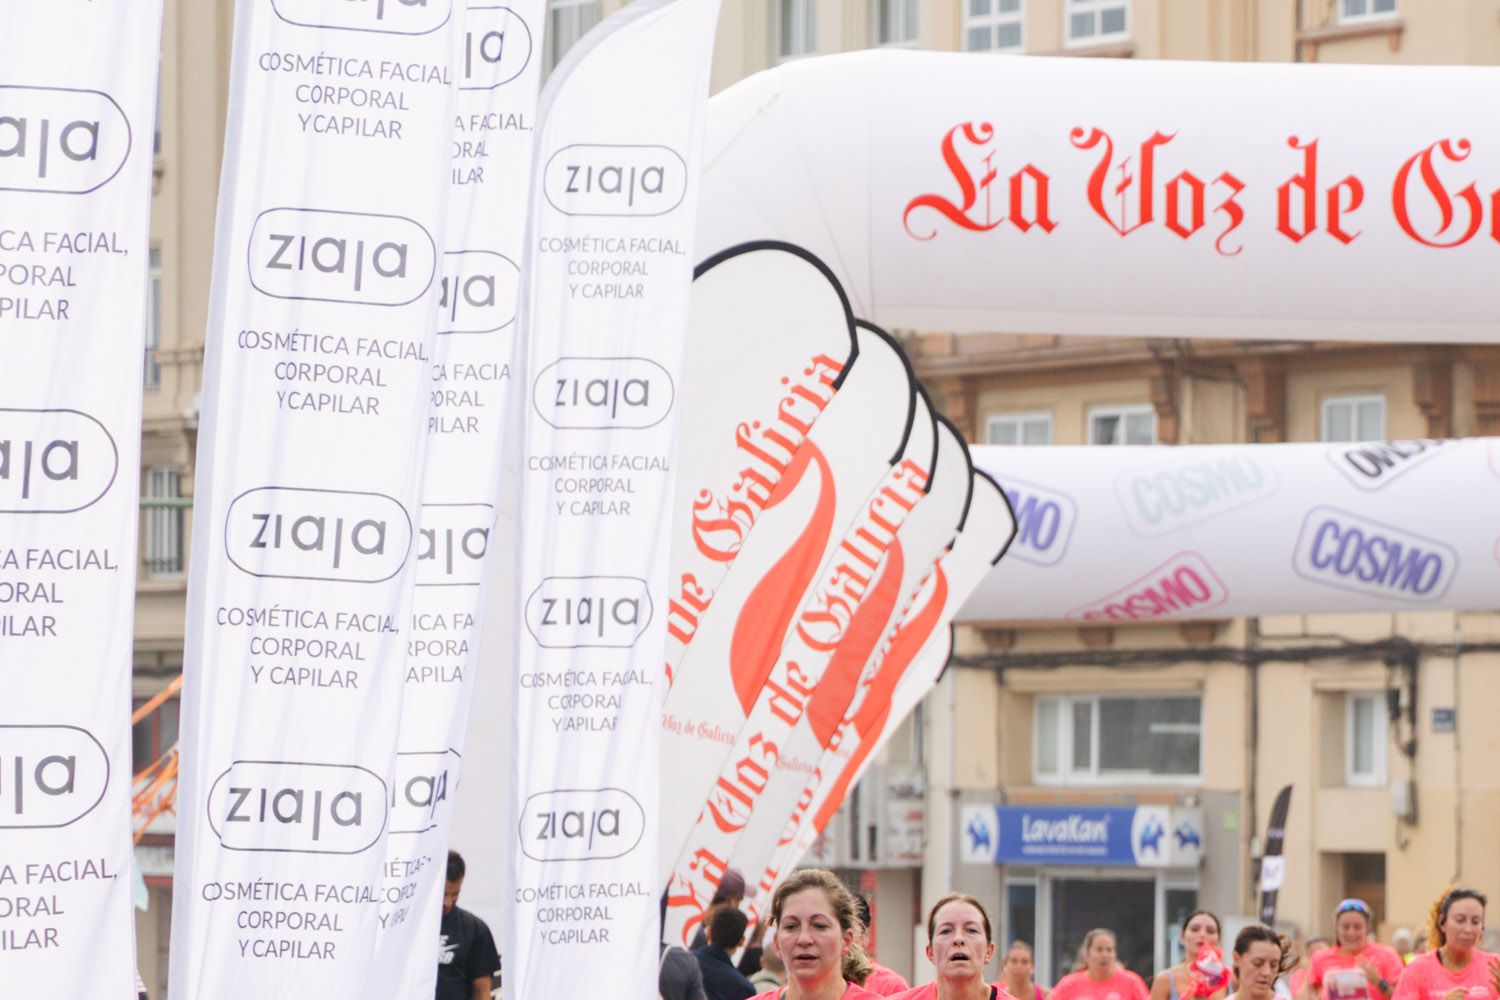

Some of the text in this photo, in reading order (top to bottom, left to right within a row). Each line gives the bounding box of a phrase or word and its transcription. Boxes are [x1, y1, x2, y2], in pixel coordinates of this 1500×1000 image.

[259, 52, 374, 79] COSMÉTICA
[295, 84, 410, 111] CORPORAL
[470, 113, 533, 132] FACIAL,
[565, 165, 665, 207] ziaja
[902, 121, 1061, 241] La
[1070, 125, 1248, 257] Voz
[1275, 135, 1365, 246] de
[43, 231, 128, 257] FACIAL,
[539, 234, 687, 256] COSMÉTICA FACIAL,
[266, 233, 408, 292] ziaja
[568, 260, 649, 276] CORPORAL
[569, 283, 644, 299] Y CAPILAR
[238, 328, 429, 364] COSMÉTICA FACIAL,
[274, 361, 387, 387] CORPORAL
[555, 378, 649, 419] ziaja
[554, 478, 636, 493] CORPORAL
[556, 501, 566, 515] Y
[249, 513, 387, 569] ziaja
[26, 549, 118, 572] FACIAL,
[1309, 518, 1443, 595] COSMO
[541, 597, 640, 638] ziaja
[250, 636, 365, 661] CORPORAL
[251, 665, 359, 689] Y CAPILAR
[226, 787, 362, 841] ziaja
[26, 858, 118, 886] FACIAL,
[589, 881, 650, 898] FACIAL,
[237, 910, 343, 932] CORPORAL
[537, 906, 613, 923] CORPORAL
